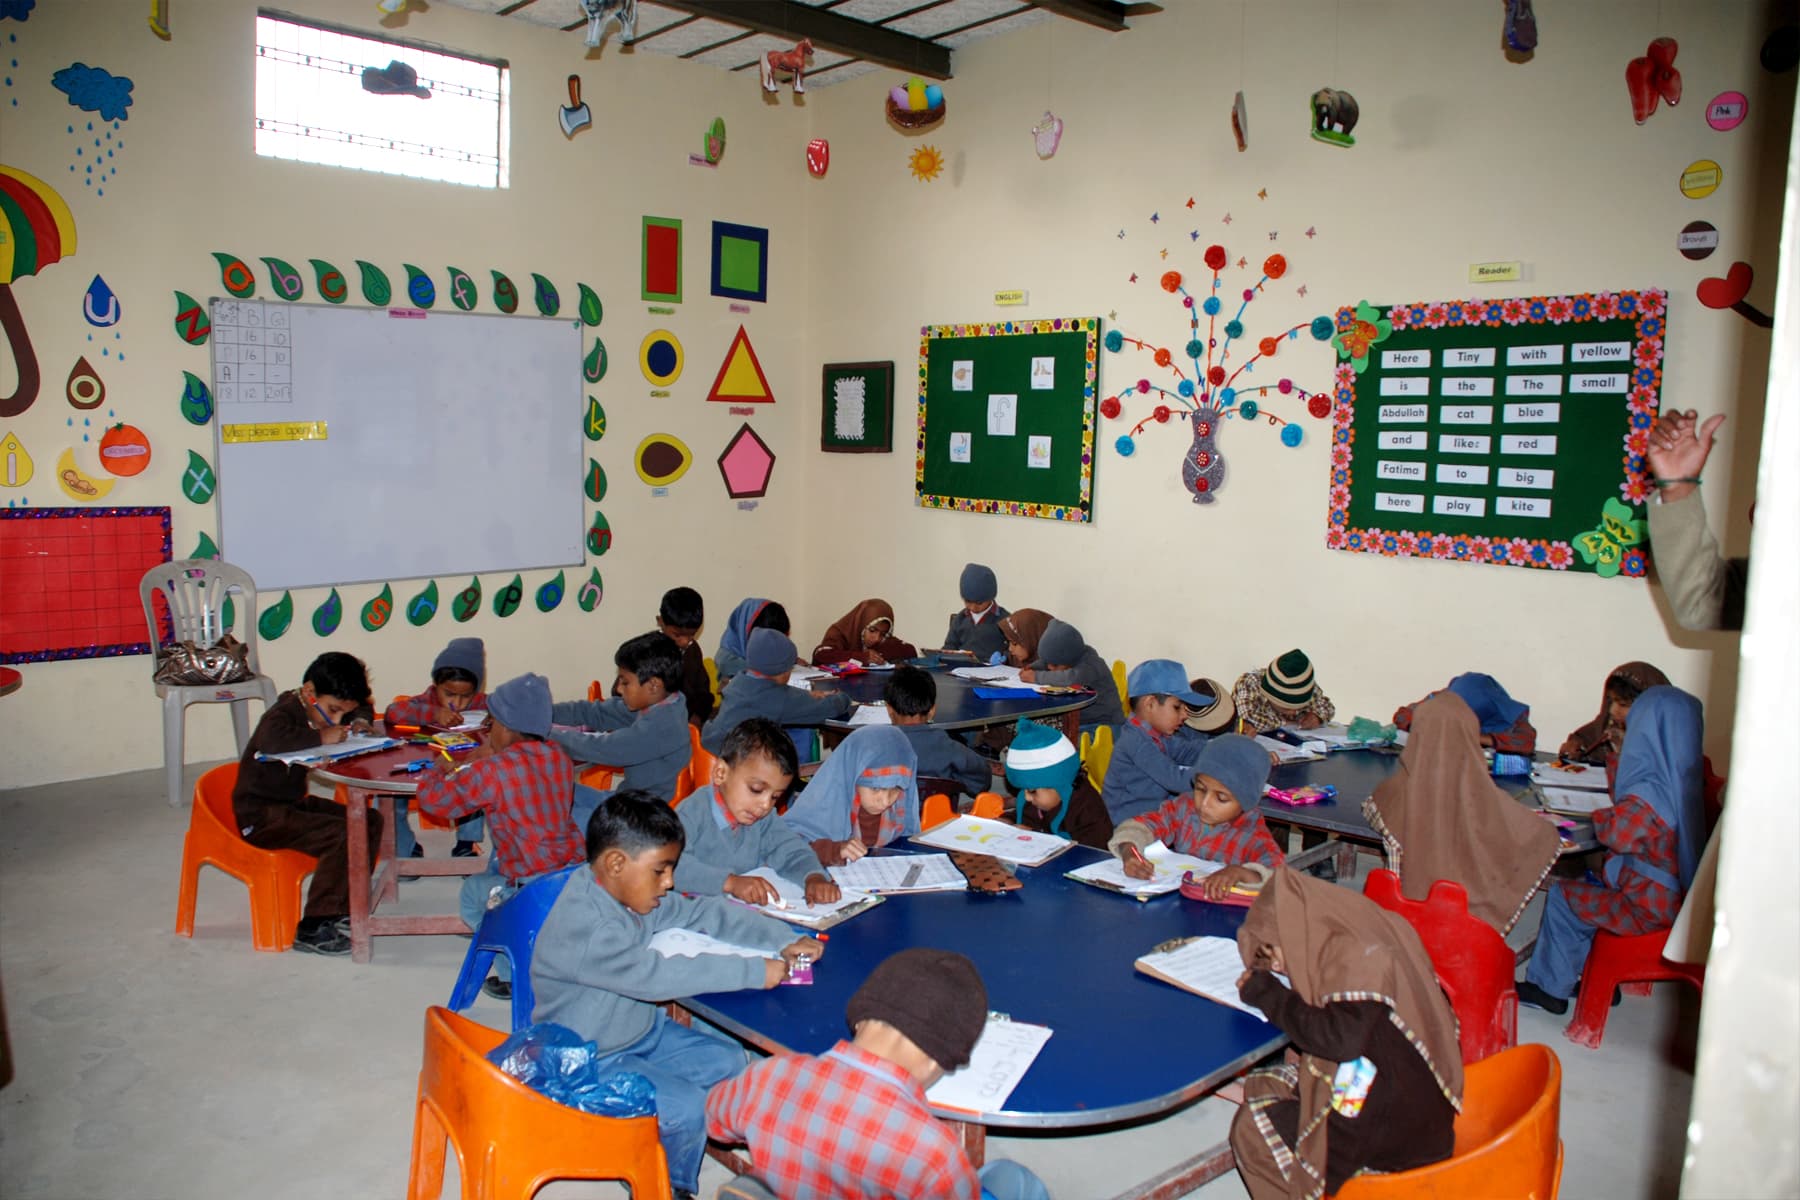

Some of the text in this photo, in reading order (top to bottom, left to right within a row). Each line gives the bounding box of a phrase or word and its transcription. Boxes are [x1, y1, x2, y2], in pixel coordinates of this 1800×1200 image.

[223, 261, 254, 292] a
[1478, 266, 1513, 276] Reader
[270, 263, 301, 296] b
[321, 272, 346, 298] c
[409, 276, 435, 304] e
[454, 274, 470, 311] f
[1393, 353, 1419, 363] Here
[1457, 351, 1480, 364] Tiny
[1520, 348, 1547, 360] with
[1579, 345, 1622, 359] yellow
[1399, 380, 1409, 391] is
[1457, 381, 1476, 391] the
[1522, 379, 1544, 390] The
[1581, 376, 1616, 388] small
[591, 401, 604, 434] k
[1381, 407, 1425, 418] Abdullah
[1456, 409, 1475, 419] cat
[1518, 407, 1544, 417] blue
[1391, 434, 1413, 445] and
[1518, 438, 1538, 449] red
[1383, 463, 1419, 475] Fatima
[1456, 469, 1468, 479] to
[1515, 472, 1535, 485] big
[1387, 496, 1411, 508] here
[1446, 500, 1471, 513] play
[1511, 500, 1535, 512] kite
[590, 528, 612, 550] m
[500, 584, 522, 617] p
[581, 581, 603, 610] n
[367, 598, 390, 626] s
